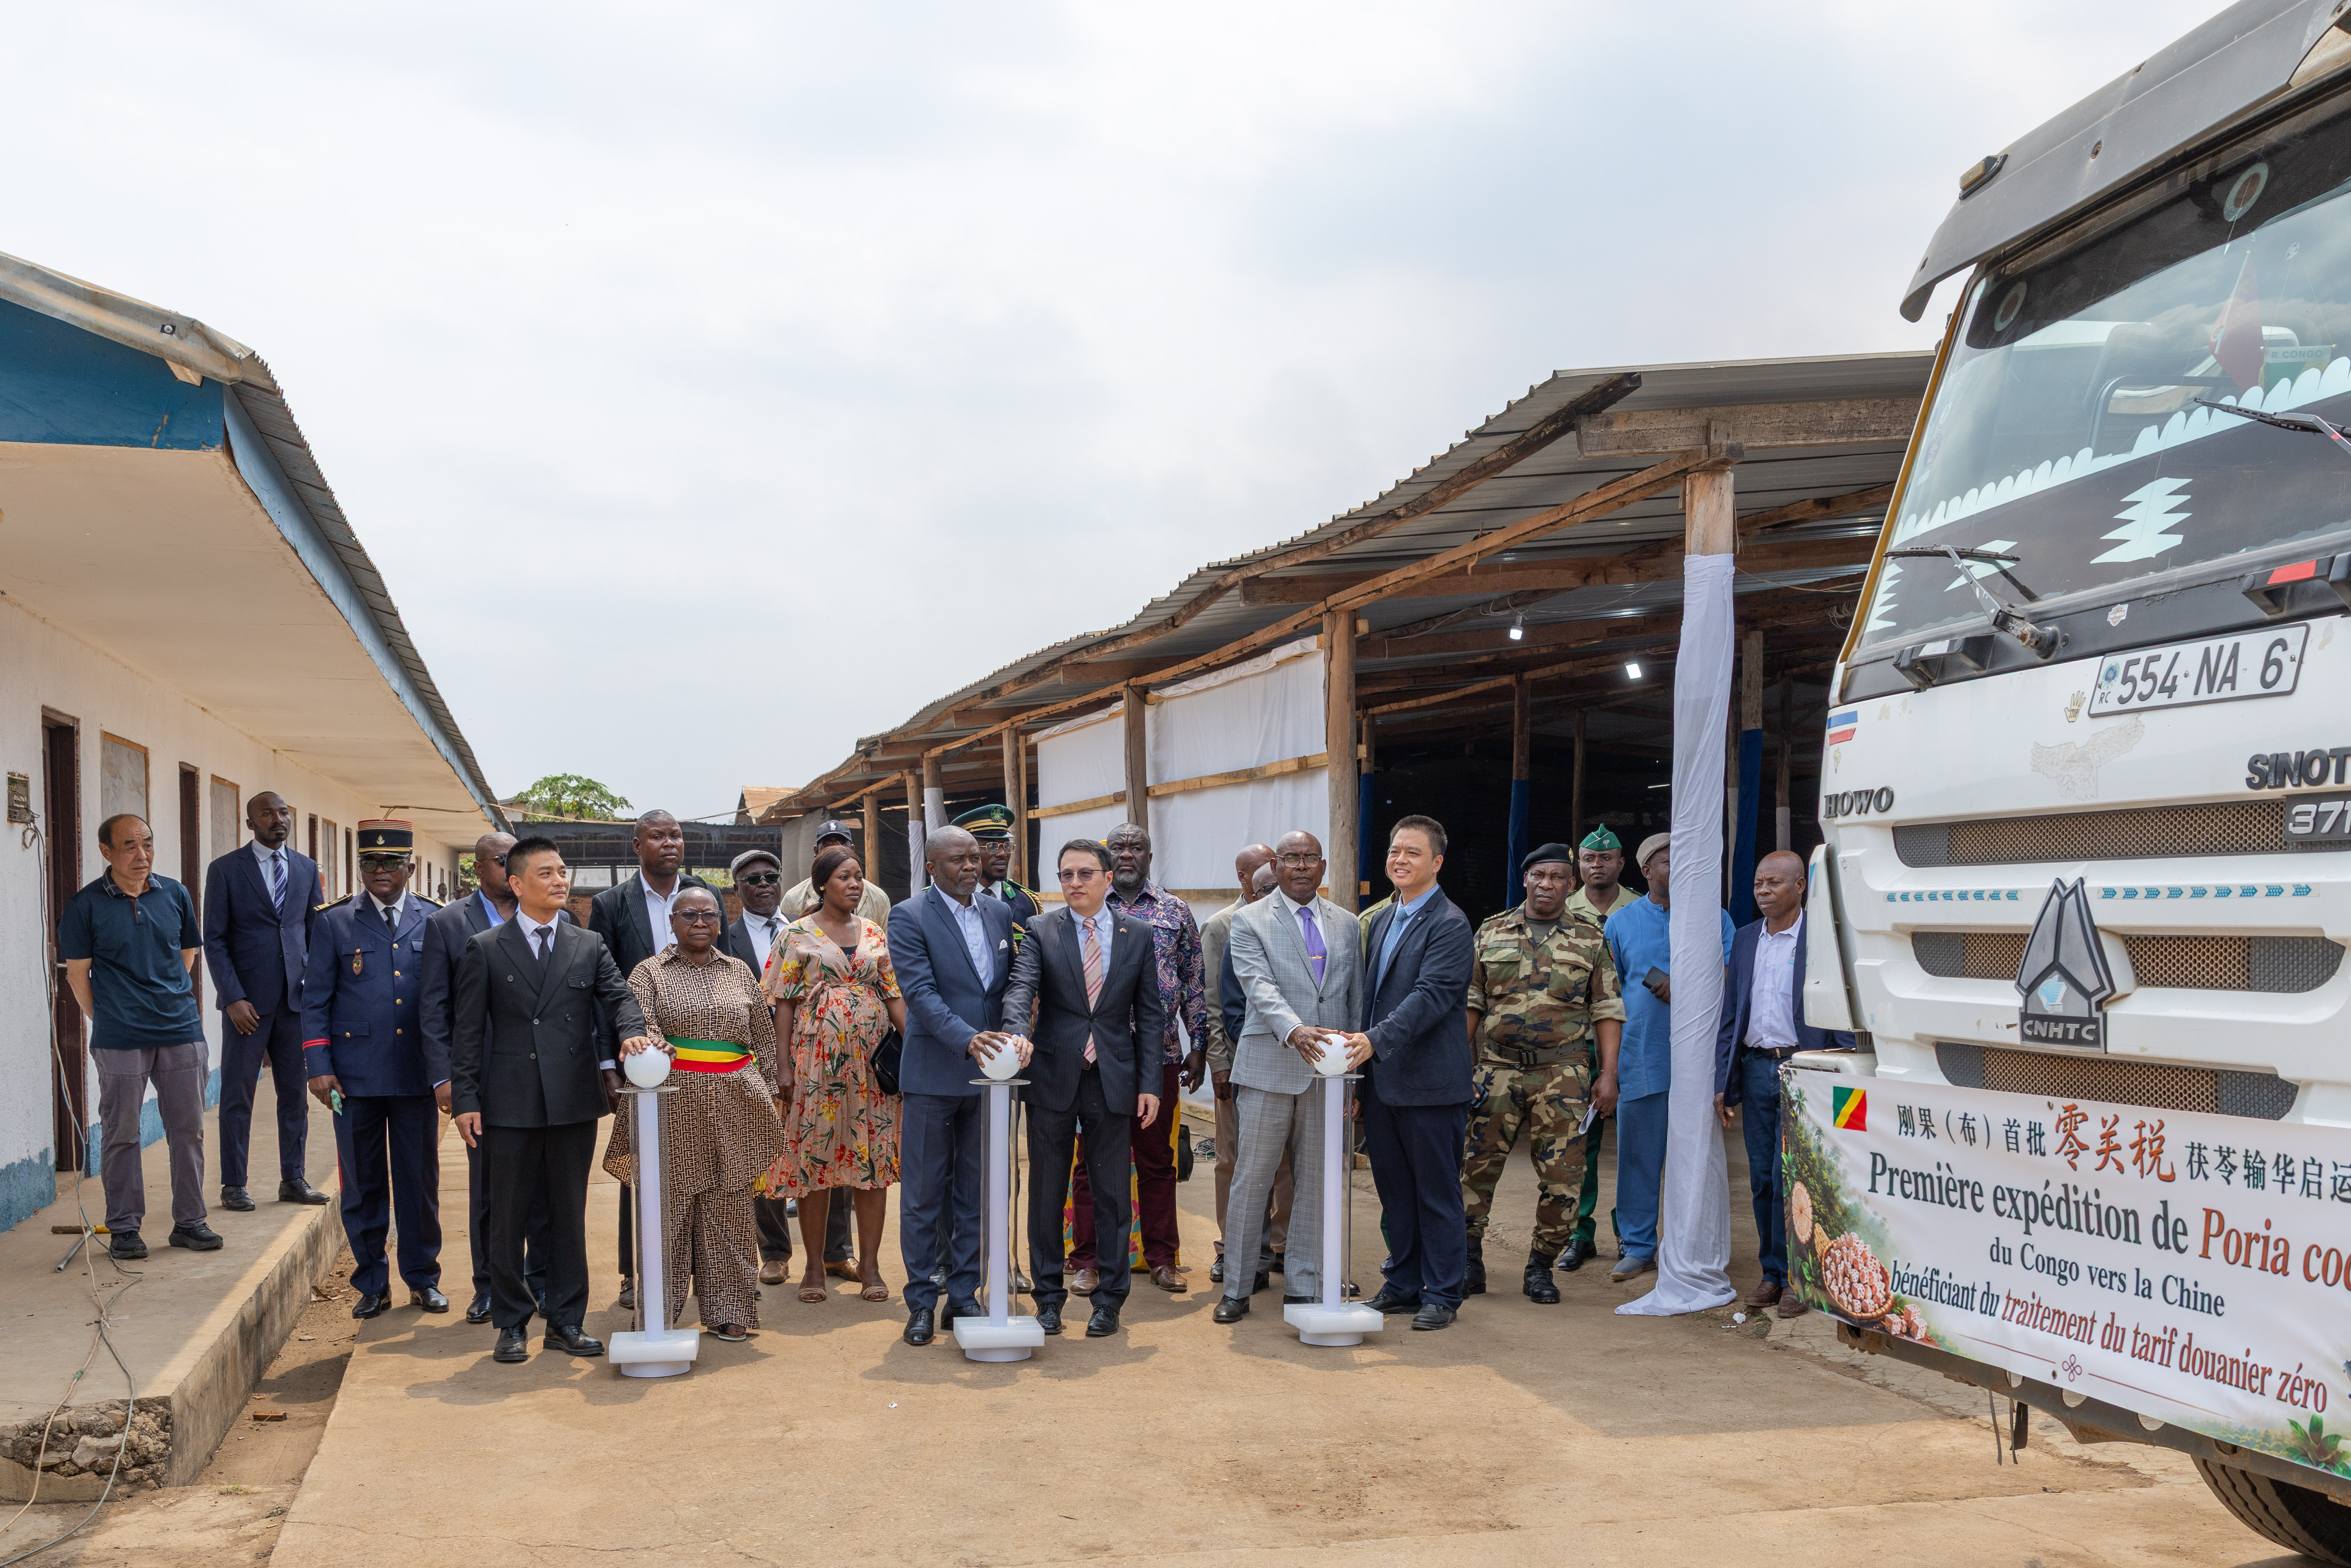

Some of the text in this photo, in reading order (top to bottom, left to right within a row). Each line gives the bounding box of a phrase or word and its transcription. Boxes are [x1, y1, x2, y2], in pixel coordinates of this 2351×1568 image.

[2271, 350, 2323, 359] R.CONGO
[2117, 638, 2288, 704] 554 NA 6
[2069, 708, 2079, 718] STOP
[2098, 691, 2111, 704] RC
[1823, 786, 1894, 818] HOWO
[2023, 1020, 2097, 1041] CNHTC
[1868, 1152, 1984, 1213] Première
[1993, 1179, 2142, 1245] expédition
[2152, 1200, 2188, 1254] de
[2199, 1207, 2289, 1276] Poria
[1990, 1237, 2225, 1317] du Congo vers la Chine
[1890, 1260, 2327, 1413] bénéficiant du traitement du tarif douanier zéro
